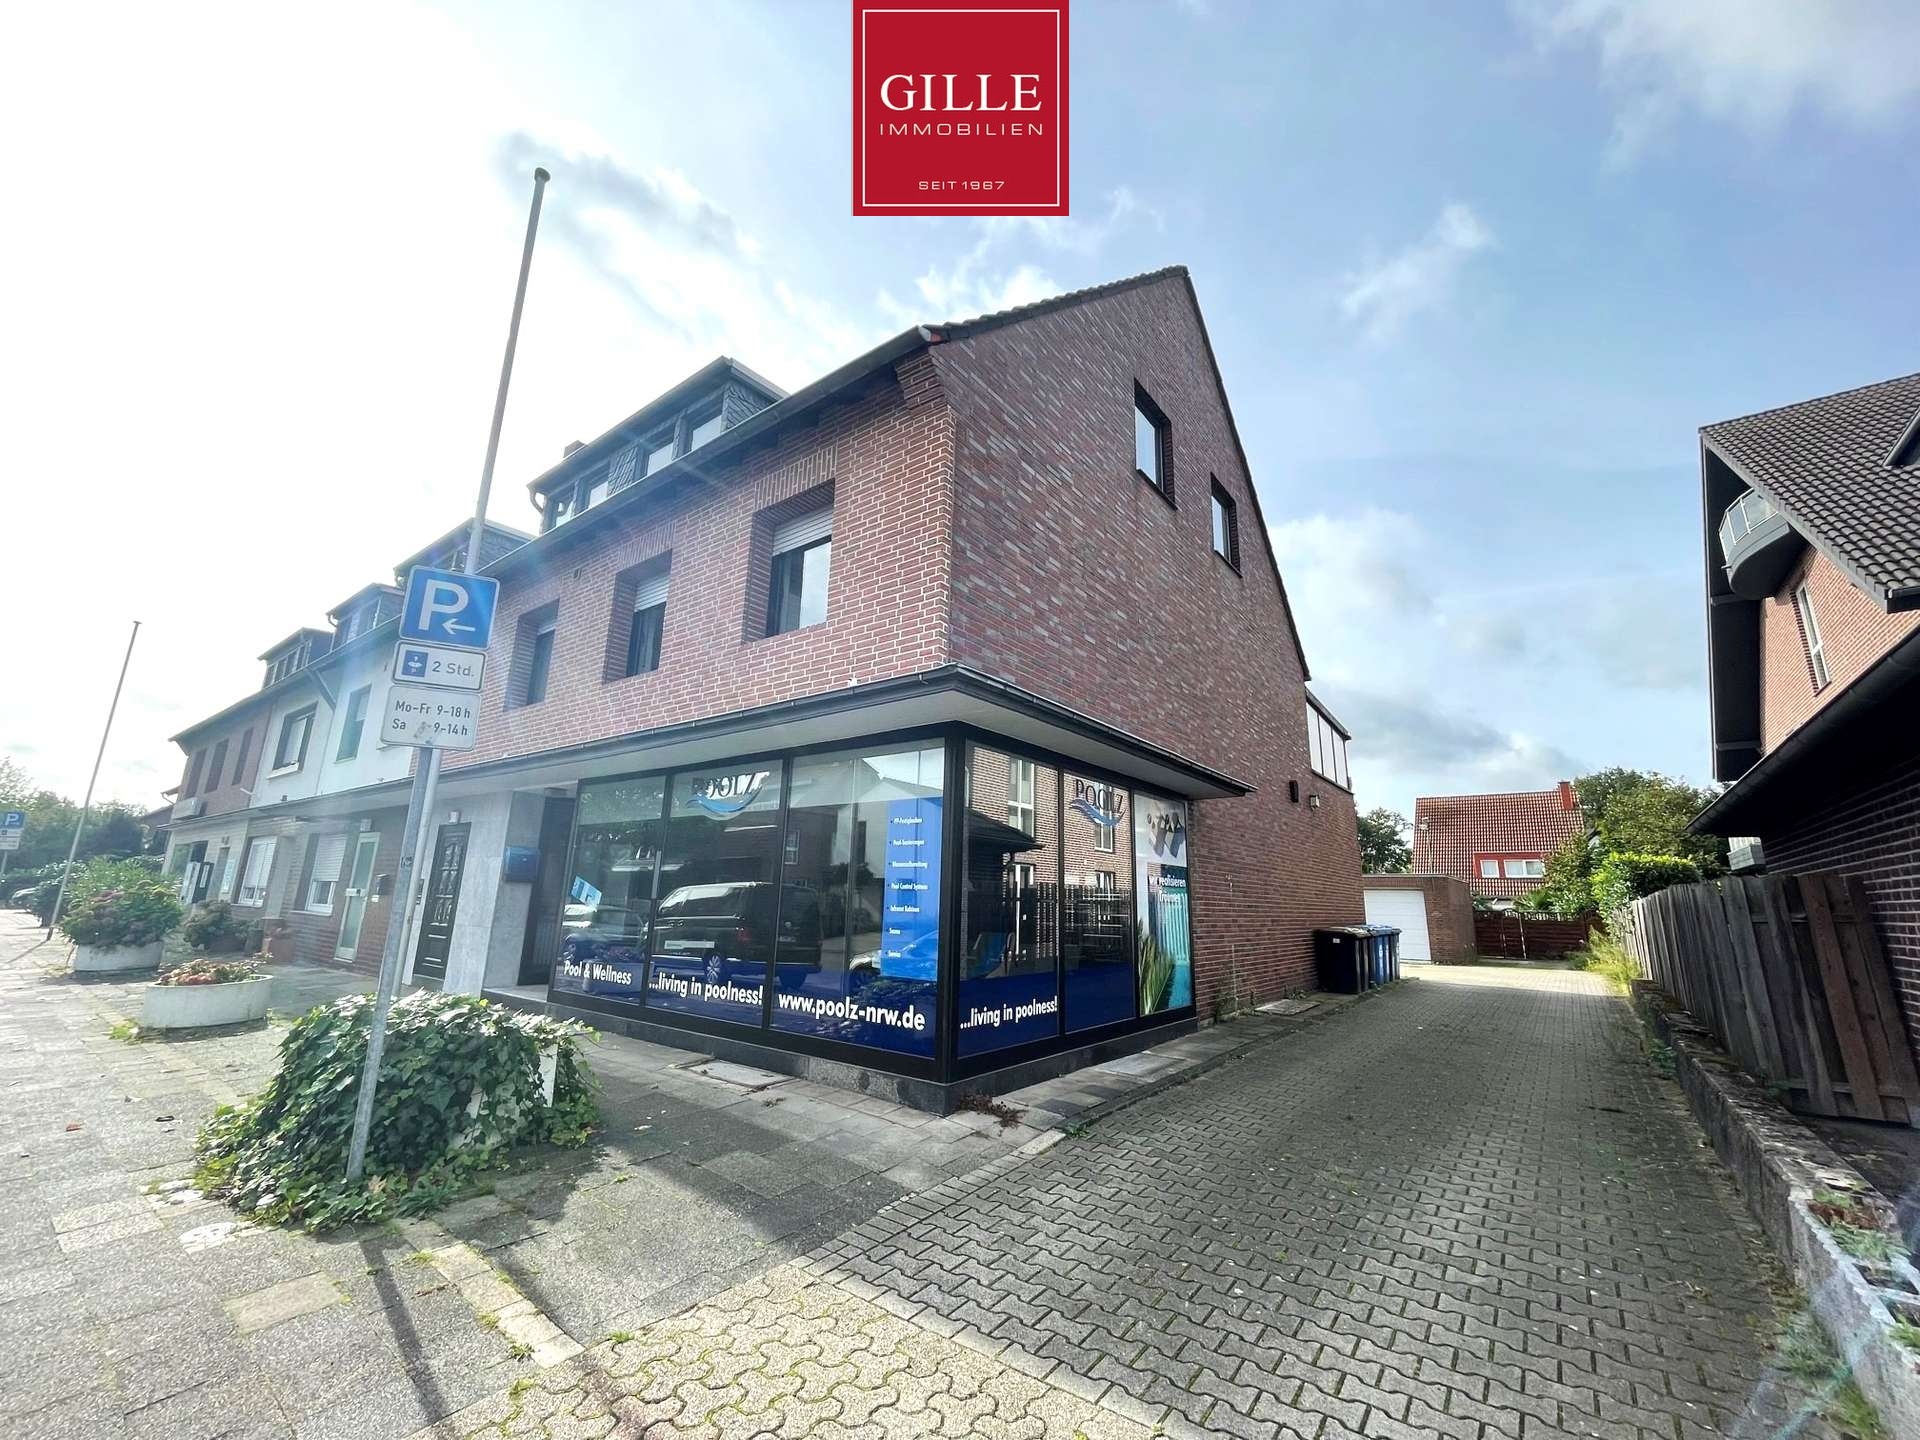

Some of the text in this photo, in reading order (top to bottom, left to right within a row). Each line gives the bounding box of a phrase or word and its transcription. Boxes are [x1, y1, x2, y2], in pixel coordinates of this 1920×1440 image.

[418, 579, 469, 631] P
[431, 661, 475, 677] 2 Std.
[395, 700, 470, 719] Mo-Fr 9-18 h
[392, 719, 468, 736] Sa 9-14 h
[564, 960, 632, 985] Pool & Wellness
[649, 972, 763, 1005] ...living in poolness!
[778, 993, 925, 1031] www.poolz-nrw.de
[960, 995, 1058, 1030] ...living in poolness!
